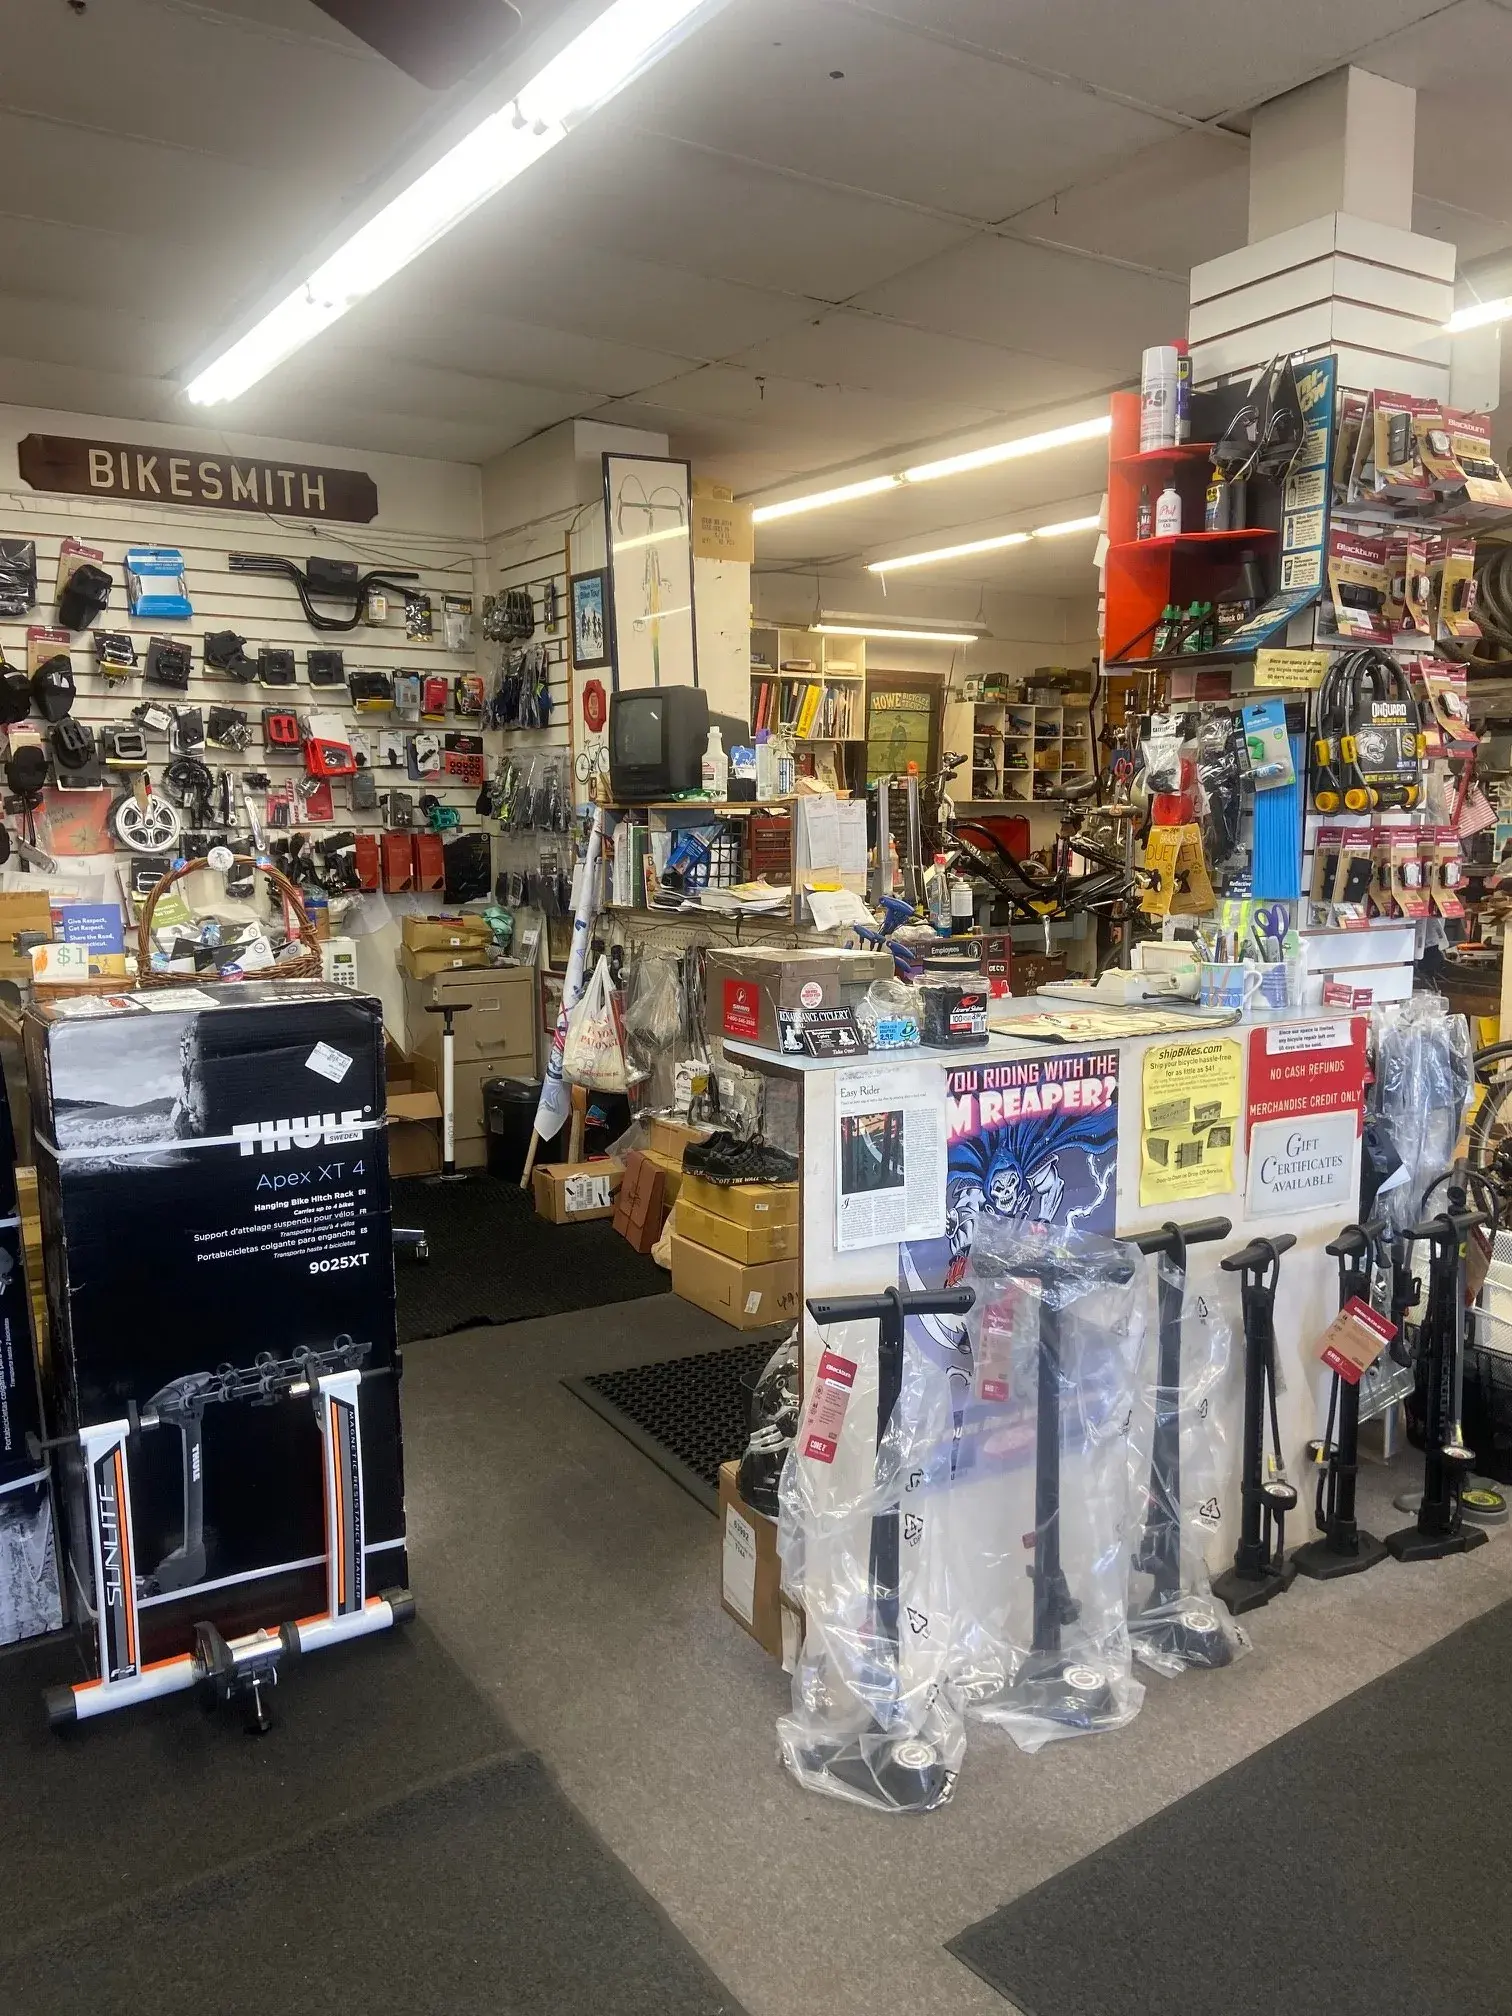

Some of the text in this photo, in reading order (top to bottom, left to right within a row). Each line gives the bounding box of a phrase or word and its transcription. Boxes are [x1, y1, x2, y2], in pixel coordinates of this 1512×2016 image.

[1448, 418, 1486, 434] Blackburn
[89, 449, 326, 510] BIKESMITH
[1159, 505, 1175, 516] Phil
[1336, 542, 1379, 560] Blackburn
[1218, 613, 1244, 623] Shock Oil
[873, 692, 902, 710] HOWE
[1159, 833, 1178, 844] BRASS
[1144, 843, 1177, 862] DUET
[81, 924, 105, 932] Respect.
[931, 946, 960, 954] Employees
[819, 1010, 850, 1022] CYCLERY
[1159, 1045, 1222, 1060] shipBikes.com
[1150, 1054, 1232, 1070] Ship your bicycle hassle-free
[1270, 1060, 1345, 1081] NO CASH REFUNDS
[983, 1063, 1039, 1090] RIDING
[1043, 1057, 1084, 1082] WITH
[1086, 1054, 1116, 1076] THE
[1165, 1069, 1174, 1077] for
[840, 1085, 880, 1098] Easy Rider
[978, 1075, 1116, 1127] REAPER?
[1250, 1090, 1362, 1116] MERCHANDISE CREDIT ONLY
[232, 1109, 363, 1156] THULE
[329, 1132, 359, 1142] SWEDEN
[256, 1159, 366, 1191] Apex XT 4
[1272, 1173, 1334, 1193] AVAILABLE
[254, 1188, 366, 1212] Hanging Bike Hitch Rack EN
[293, 1207, 315, 1216] Carries
[315, 1205, 324, 1214] up
[338, 1201, 354, 1209] bikes
[193, 1229, 228, 1242] Support
[230, 1222, 272, 1236] d'attelage
[273, 1216, 312, 1230] suspendu
[313, 1213, 332, 1224] pour
[334, 1209, 354, 1220] vélos
[280, 1227, 312, 1238] Transporte
[340, 1220, 355, 1228] vélos
[197, 1245, 259, 1262] Portabicicletas
[260, 1238, 296, 1252] colgante
[297, 1235, 316, 1246] para
[317, 1228, 356, 1242] enganche
[306, 1245, 323, 1254] hasta
[329, 1239, 356, 1250] bicicletas
[309, 1253, 370, 1275] 9025XT
[1353, 1306, 1387, 1334] Blackburn
[1326, 1350, 1341, 1363] GRID
[826, 1363, 852, 1378] Blackburn
[2, 1400, 12, 1450] Portabicicletas
[348, 1411, 358, 1470] MAGNETIC
[810, 1440, 823, 1451] CORE
[191, 1443, 200, 1482] THULE
[352, 1475, 362, 1543] RESISTANCE
[98, 1484, 122, 1607] SUNLITE
[110, 1664, 136, 1678] F-2
